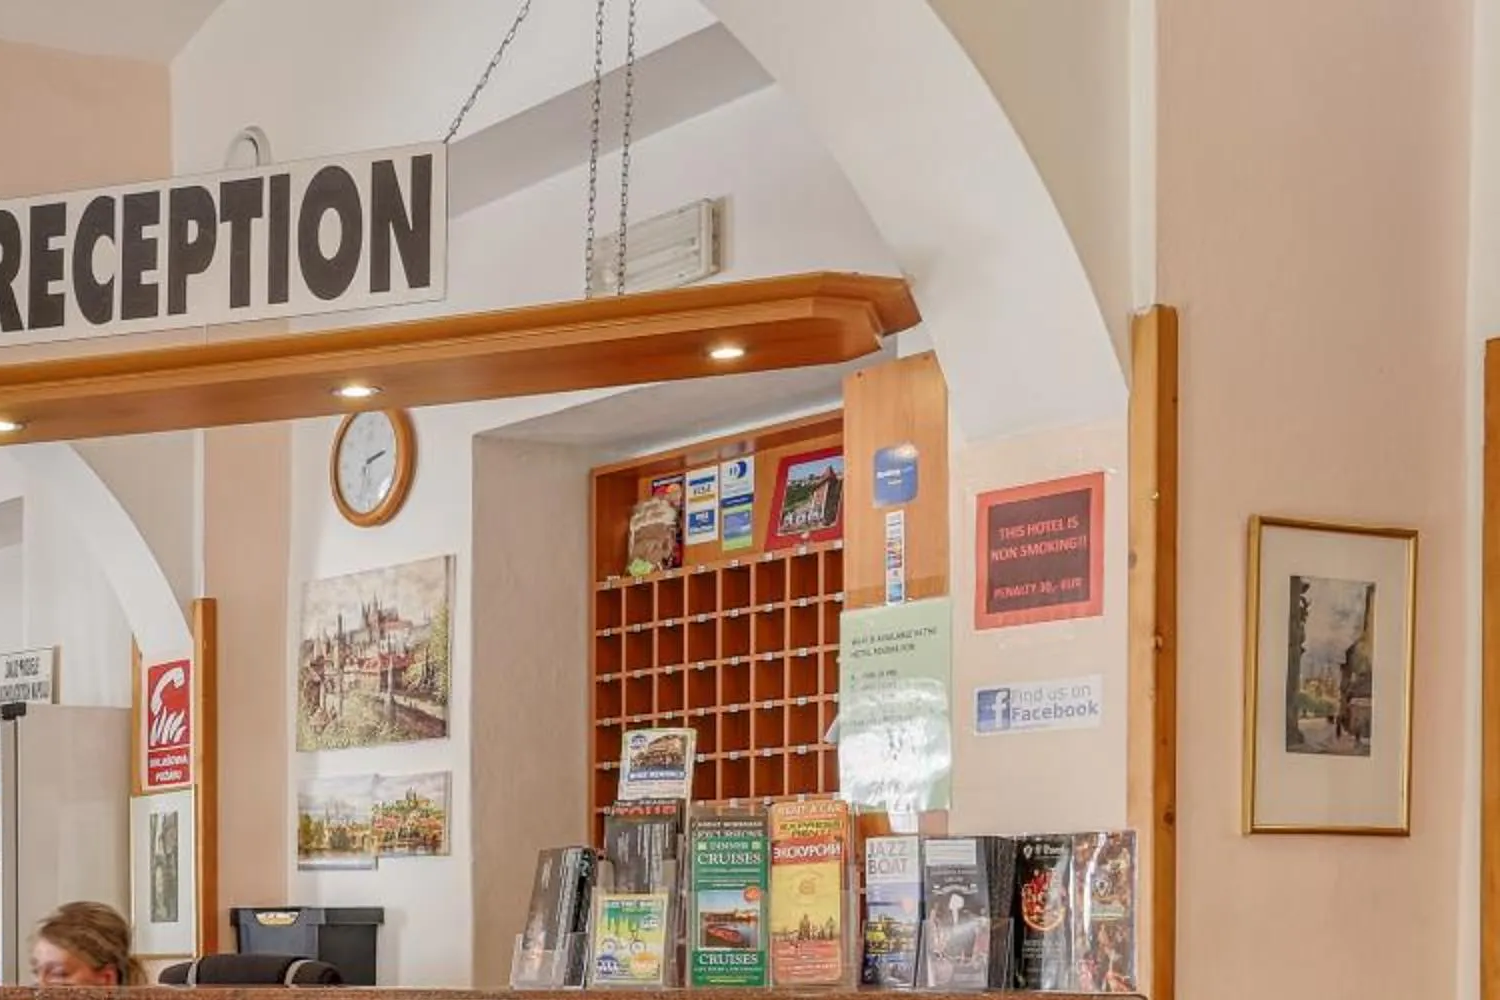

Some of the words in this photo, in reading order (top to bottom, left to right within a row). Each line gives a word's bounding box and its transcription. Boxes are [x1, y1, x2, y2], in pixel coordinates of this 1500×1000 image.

[999, 527, 1026, 541] THIS
[1027, 519, 1064, 536] HOTEL
[1065, 515, 1080, 530] IS
[991, 546, 1019, 562] NON
[994, 580, 1038, 599] PENALTY
[1060, 576, 1083, 591] EUR
[1011, 687, 1045, 706] Find
[1047, 688, 1067, 701] us
[1071, 685, 1092, 699] on
[1012, 700, 1099, 722] Facebook
[868, 840, 907, 858] JAZZ
[697, 852, 762, 865] CRUISES
[868, 858, 909, 875] BOAT
[699, 953, 759, 965] CRUISES
